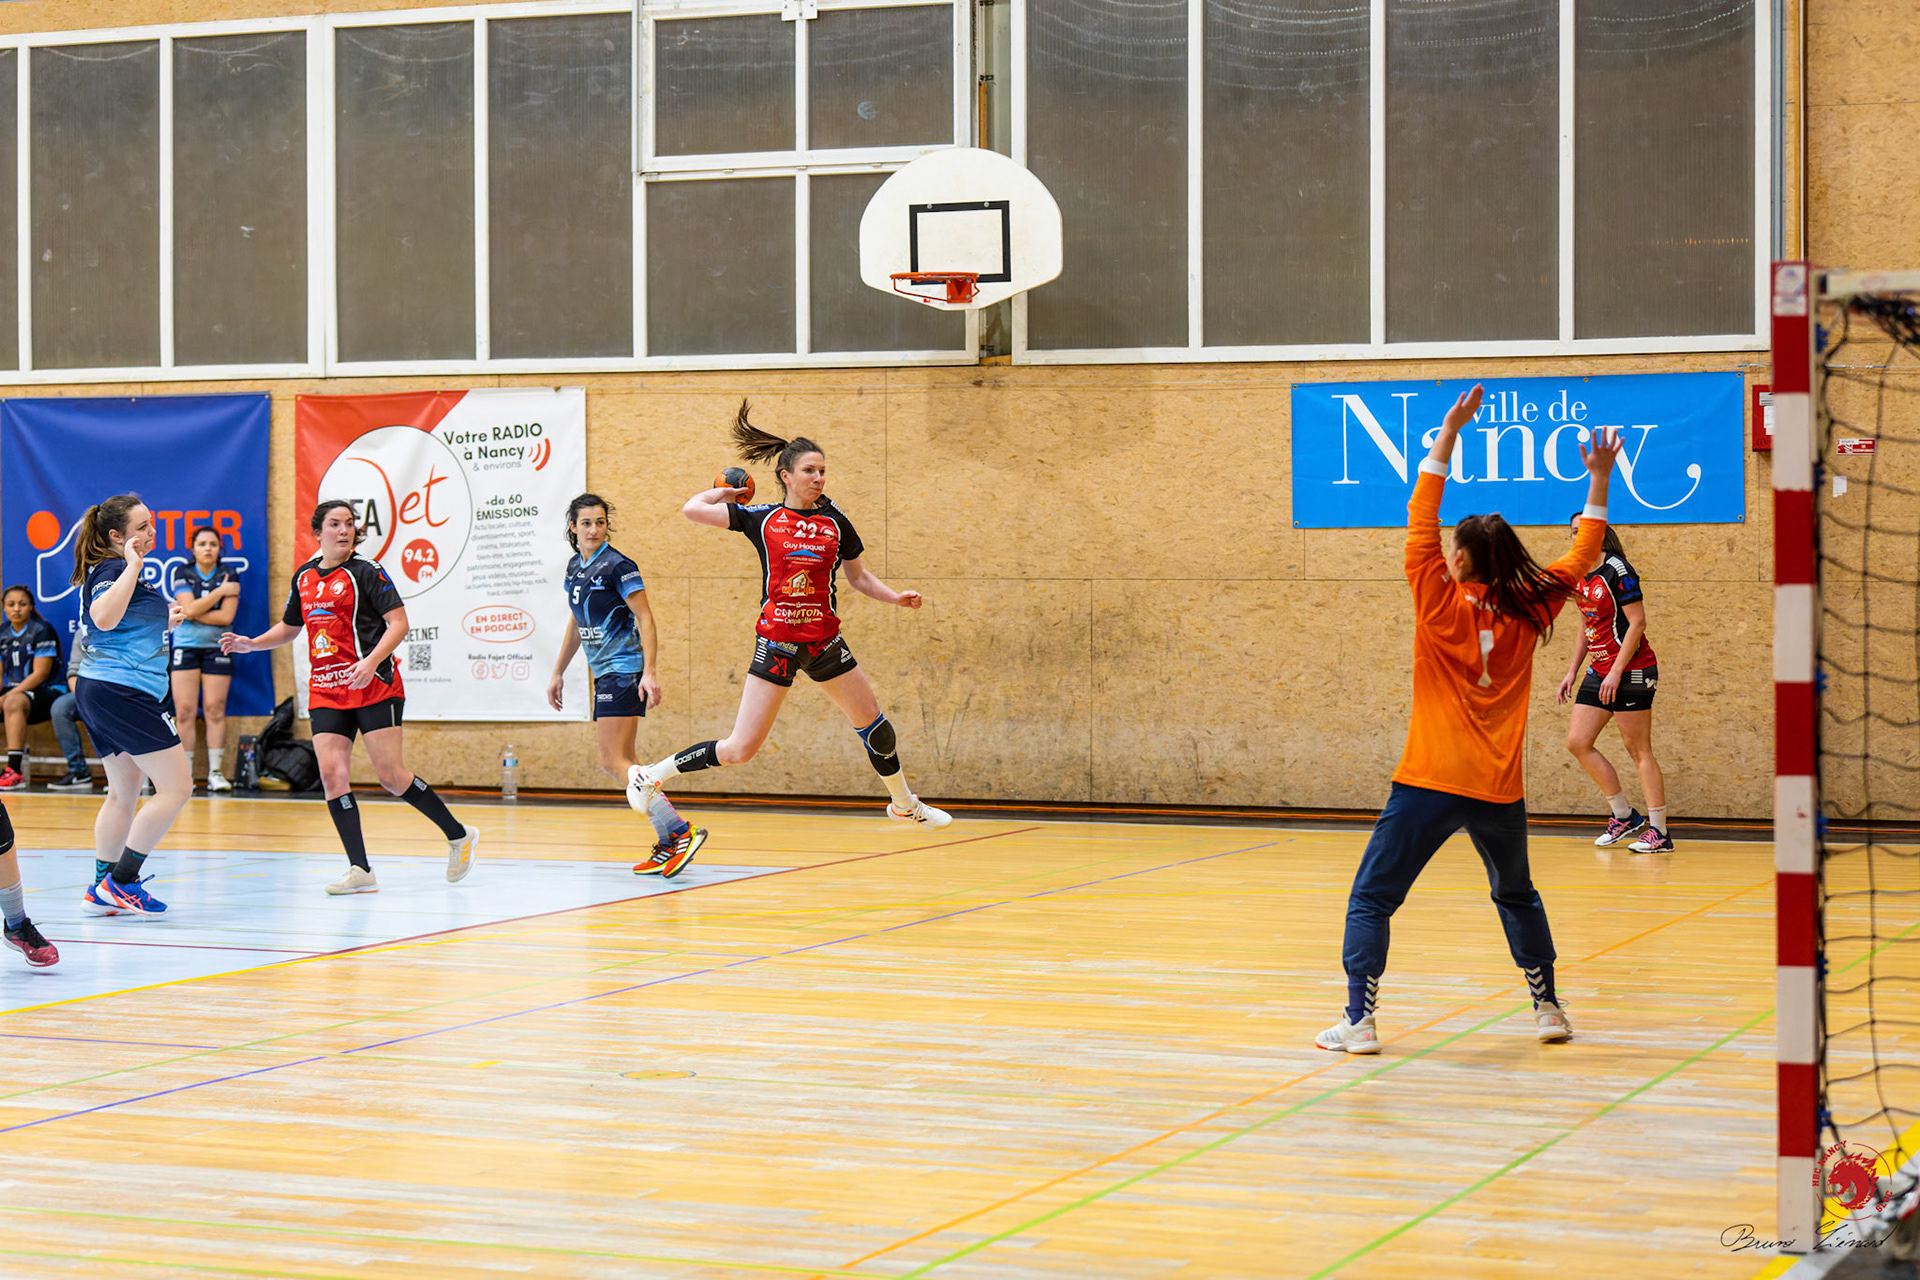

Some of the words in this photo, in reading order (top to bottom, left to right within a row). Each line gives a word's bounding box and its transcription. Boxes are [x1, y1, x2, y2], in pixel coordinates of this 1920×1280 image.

[1473, 390, 1538, 424] ville
[1549, 389, 1588, 422] de
[443, 431, 488, 446] Votre
[492, 422, 543, 441] RADIO
[464, 447, 473, 460] à
[478, 446, 525, 460] Nancy
[1331, 393, 1702, 510] Nancy
[473, 463, 479, 471] &
[483, 460, 522, 471] environs
[508, 494, 522, 504] 60
[476, 506, 539, 520] ÉMISSIONS
[782, 541, 797, 550] Guy
[799, 542, 826, 552] Hoquet
[403, 548, 434, 563] 94.2
[421, 571, 433, 579] FM
[572, 585, 581, 605] 5
[475, 615, 487, 624] EN
[490, 612, 523, 622] DIRECT
[470, 626, 482, 634] EN
[484, 622, 528, 633] PODCAST
